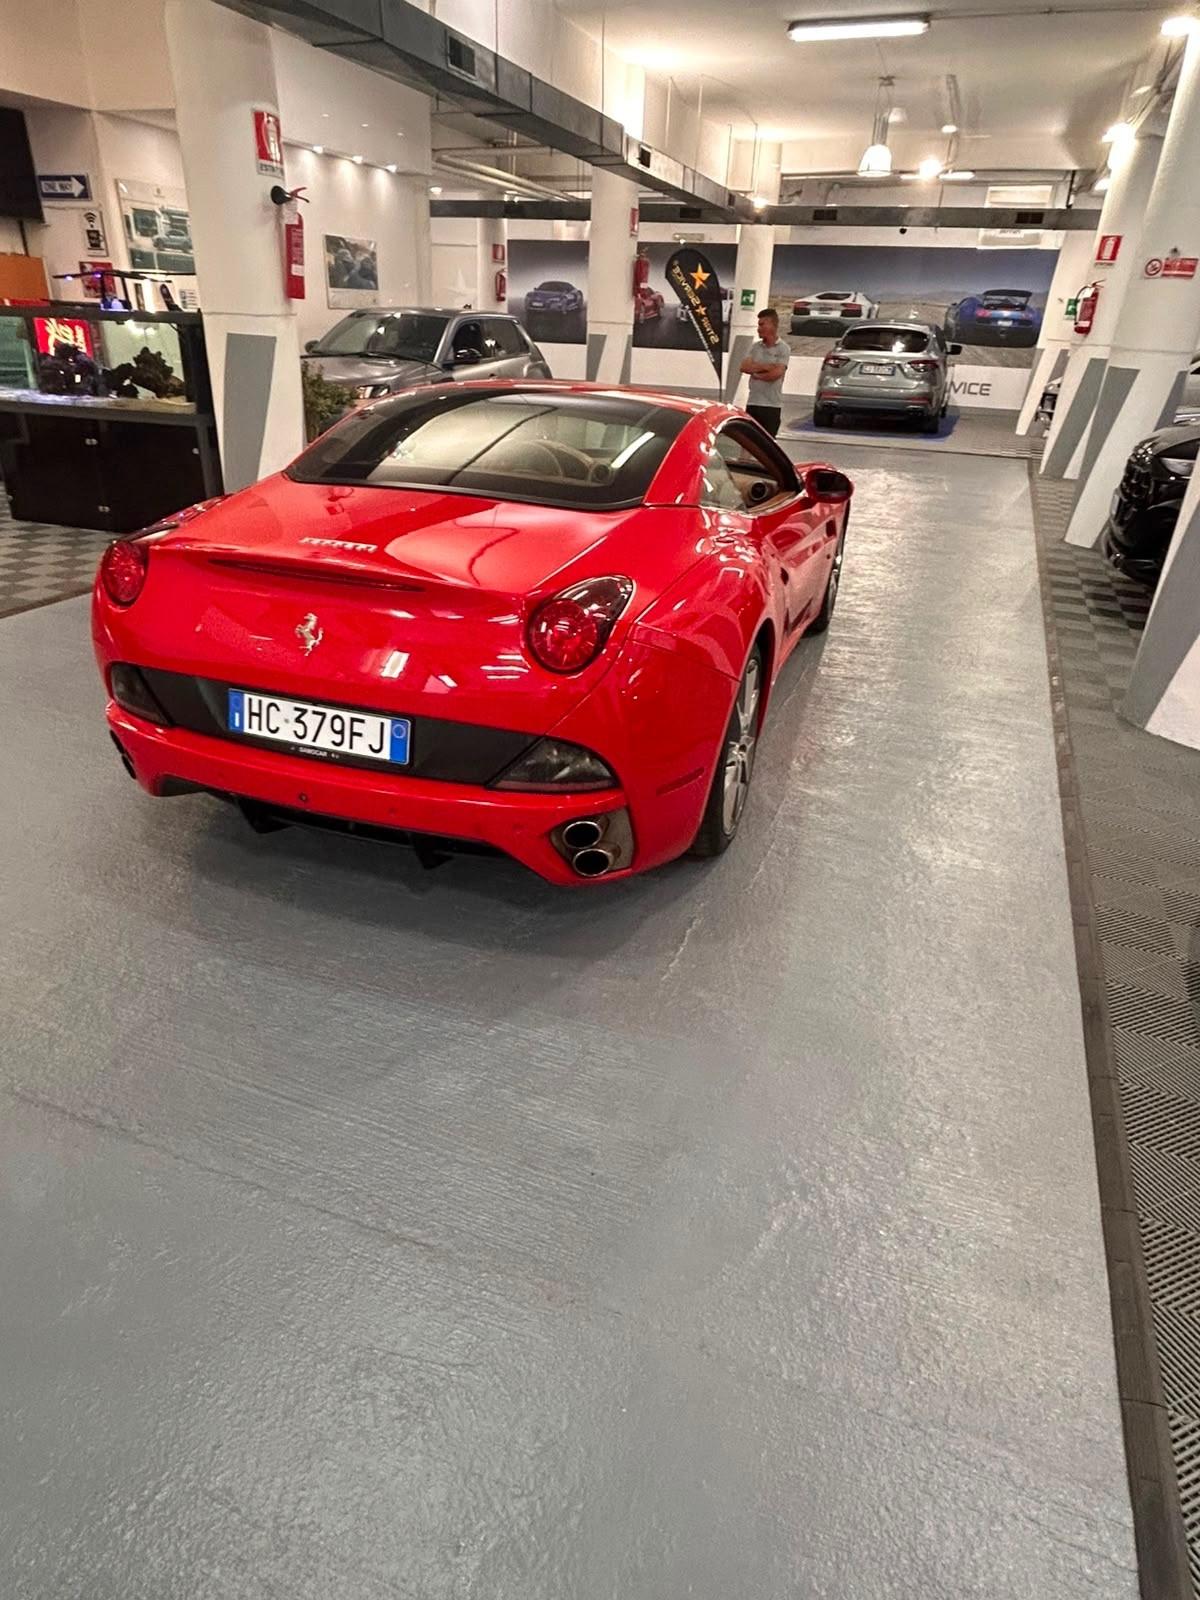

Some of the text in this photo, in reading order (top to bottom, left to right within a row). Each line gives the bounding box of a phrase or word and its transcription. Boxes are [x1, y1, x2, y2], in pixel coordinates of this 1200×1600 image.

[949, 381, 992, 396] VICE
[248, 697, 385, 753] HC 379FJ
